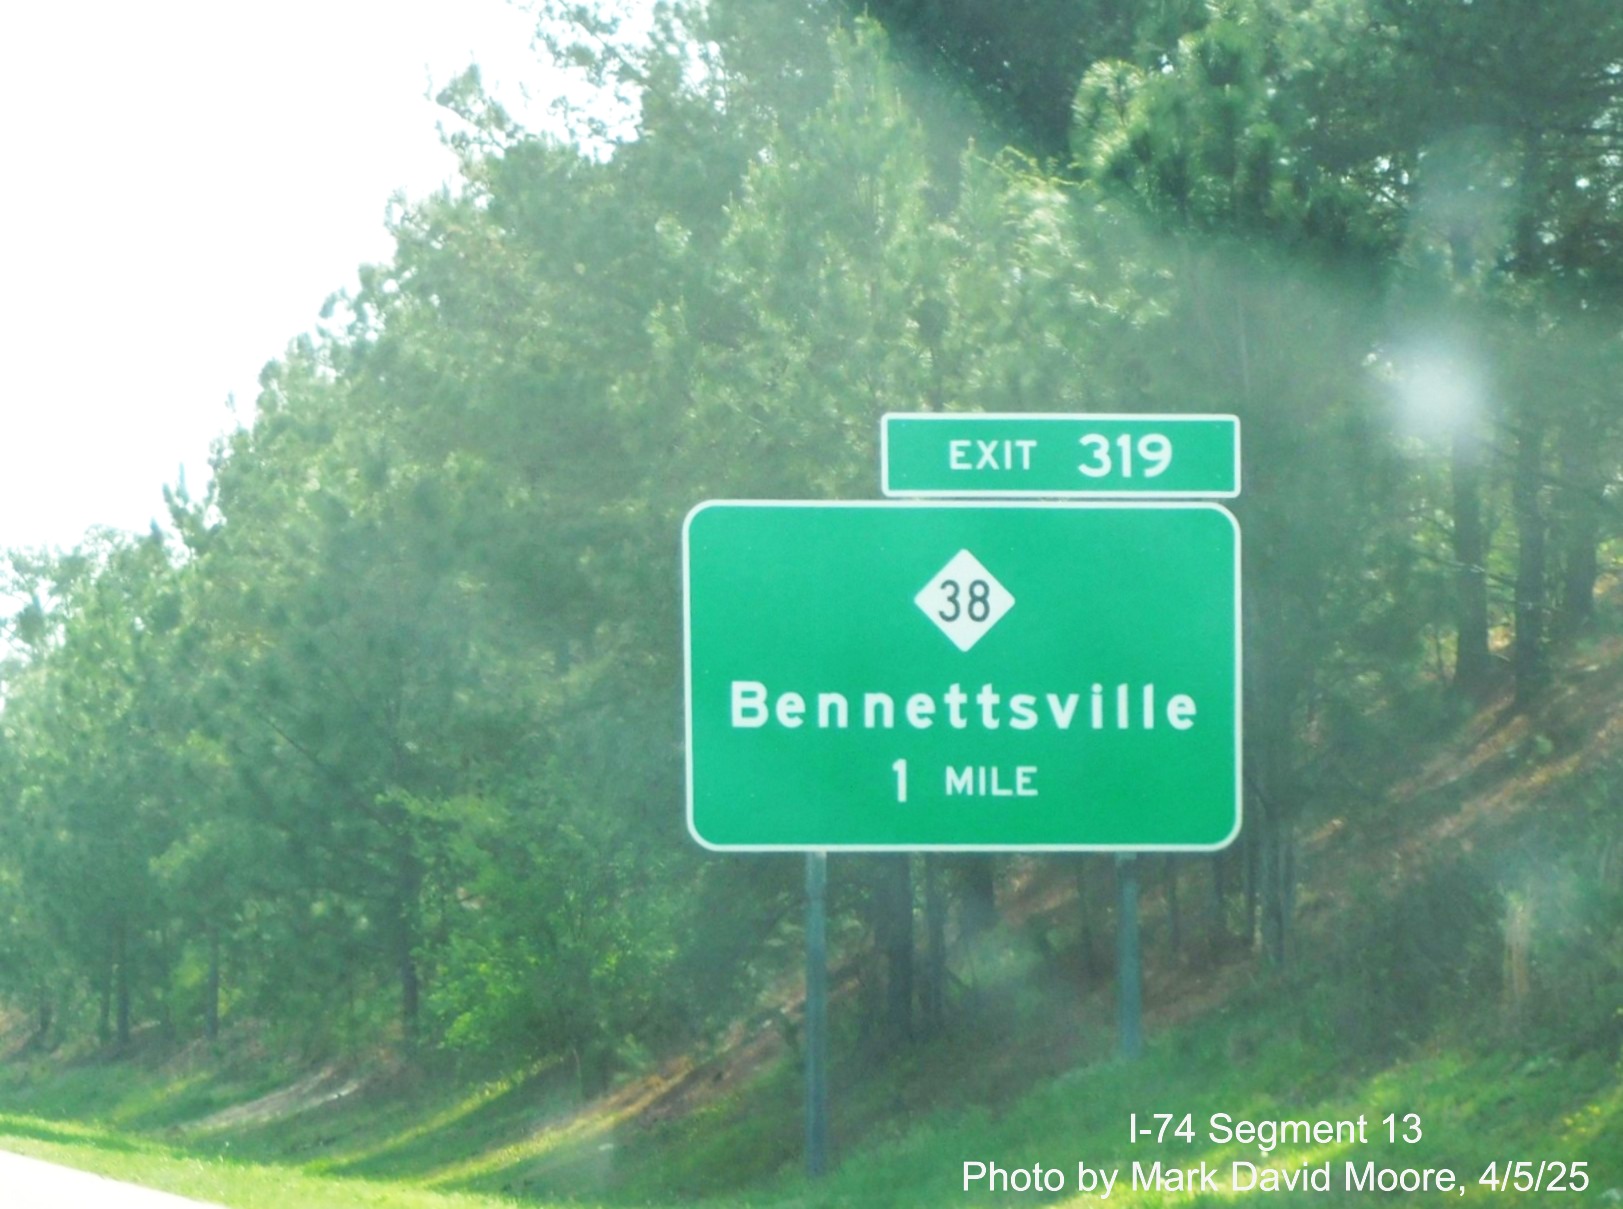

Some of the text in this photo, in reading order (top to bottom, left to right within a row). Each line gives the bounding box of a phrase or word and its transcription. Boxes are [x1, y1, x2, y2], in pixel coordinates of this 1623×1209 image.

[949, 433, 1173, 478] EXIT 319
[938, 579, 991, 622] 38
[731, 681, 1197, 730] Bennettsville
[892, 759, 1038, 802] 1 MILE
